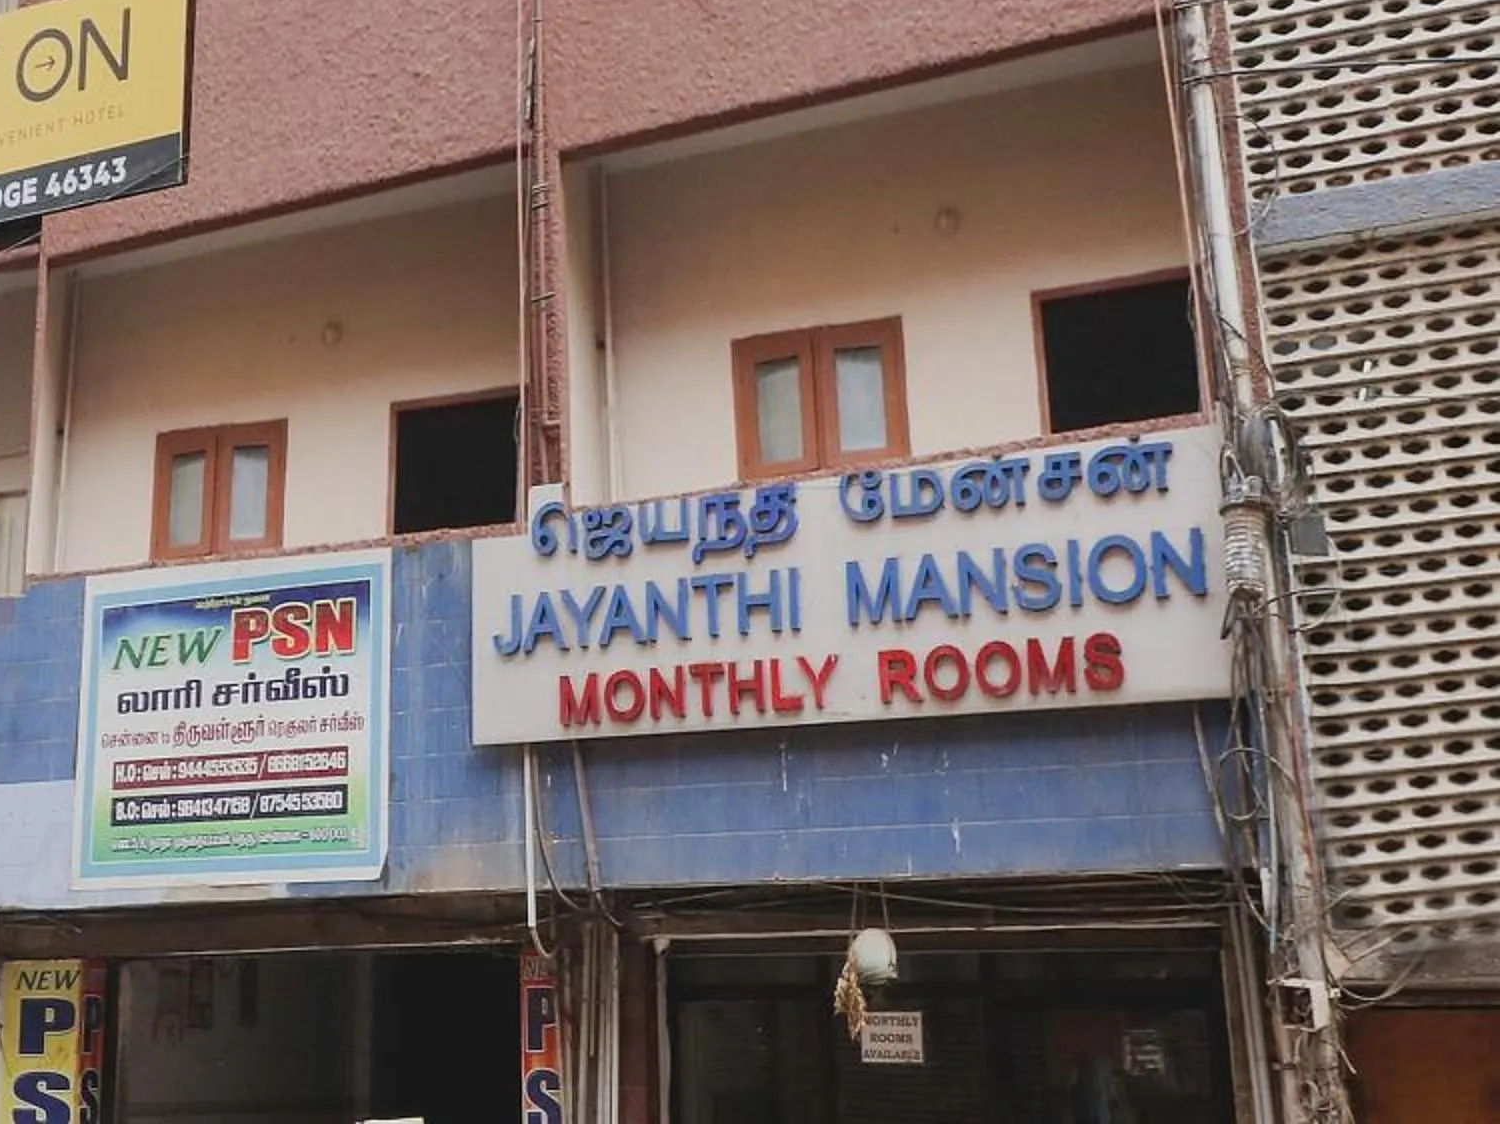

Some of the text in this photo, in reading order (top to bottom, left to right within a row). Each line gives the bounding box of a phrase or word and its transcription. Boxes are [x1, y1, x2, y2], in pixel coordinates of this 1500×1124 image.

[16, 7, 131, 102] ON
[73, 104, 126, 126] HOTEL
[45, 156, 128, 200] 46343
[840, 434, 1173, 522] மேன்சன்
[492, 527, 1209, 656] JAYANTHI MANSION
[112, 597, 357, 671] NEW PSN
[117, 665, 349, 714] லாரி சர்வீஸ்
[558, 632, 1125, 728] MONTHLY ROOMS
[15, 970, 81, 990] NEW
[870, 1032, 913, 1043] ROOMS
